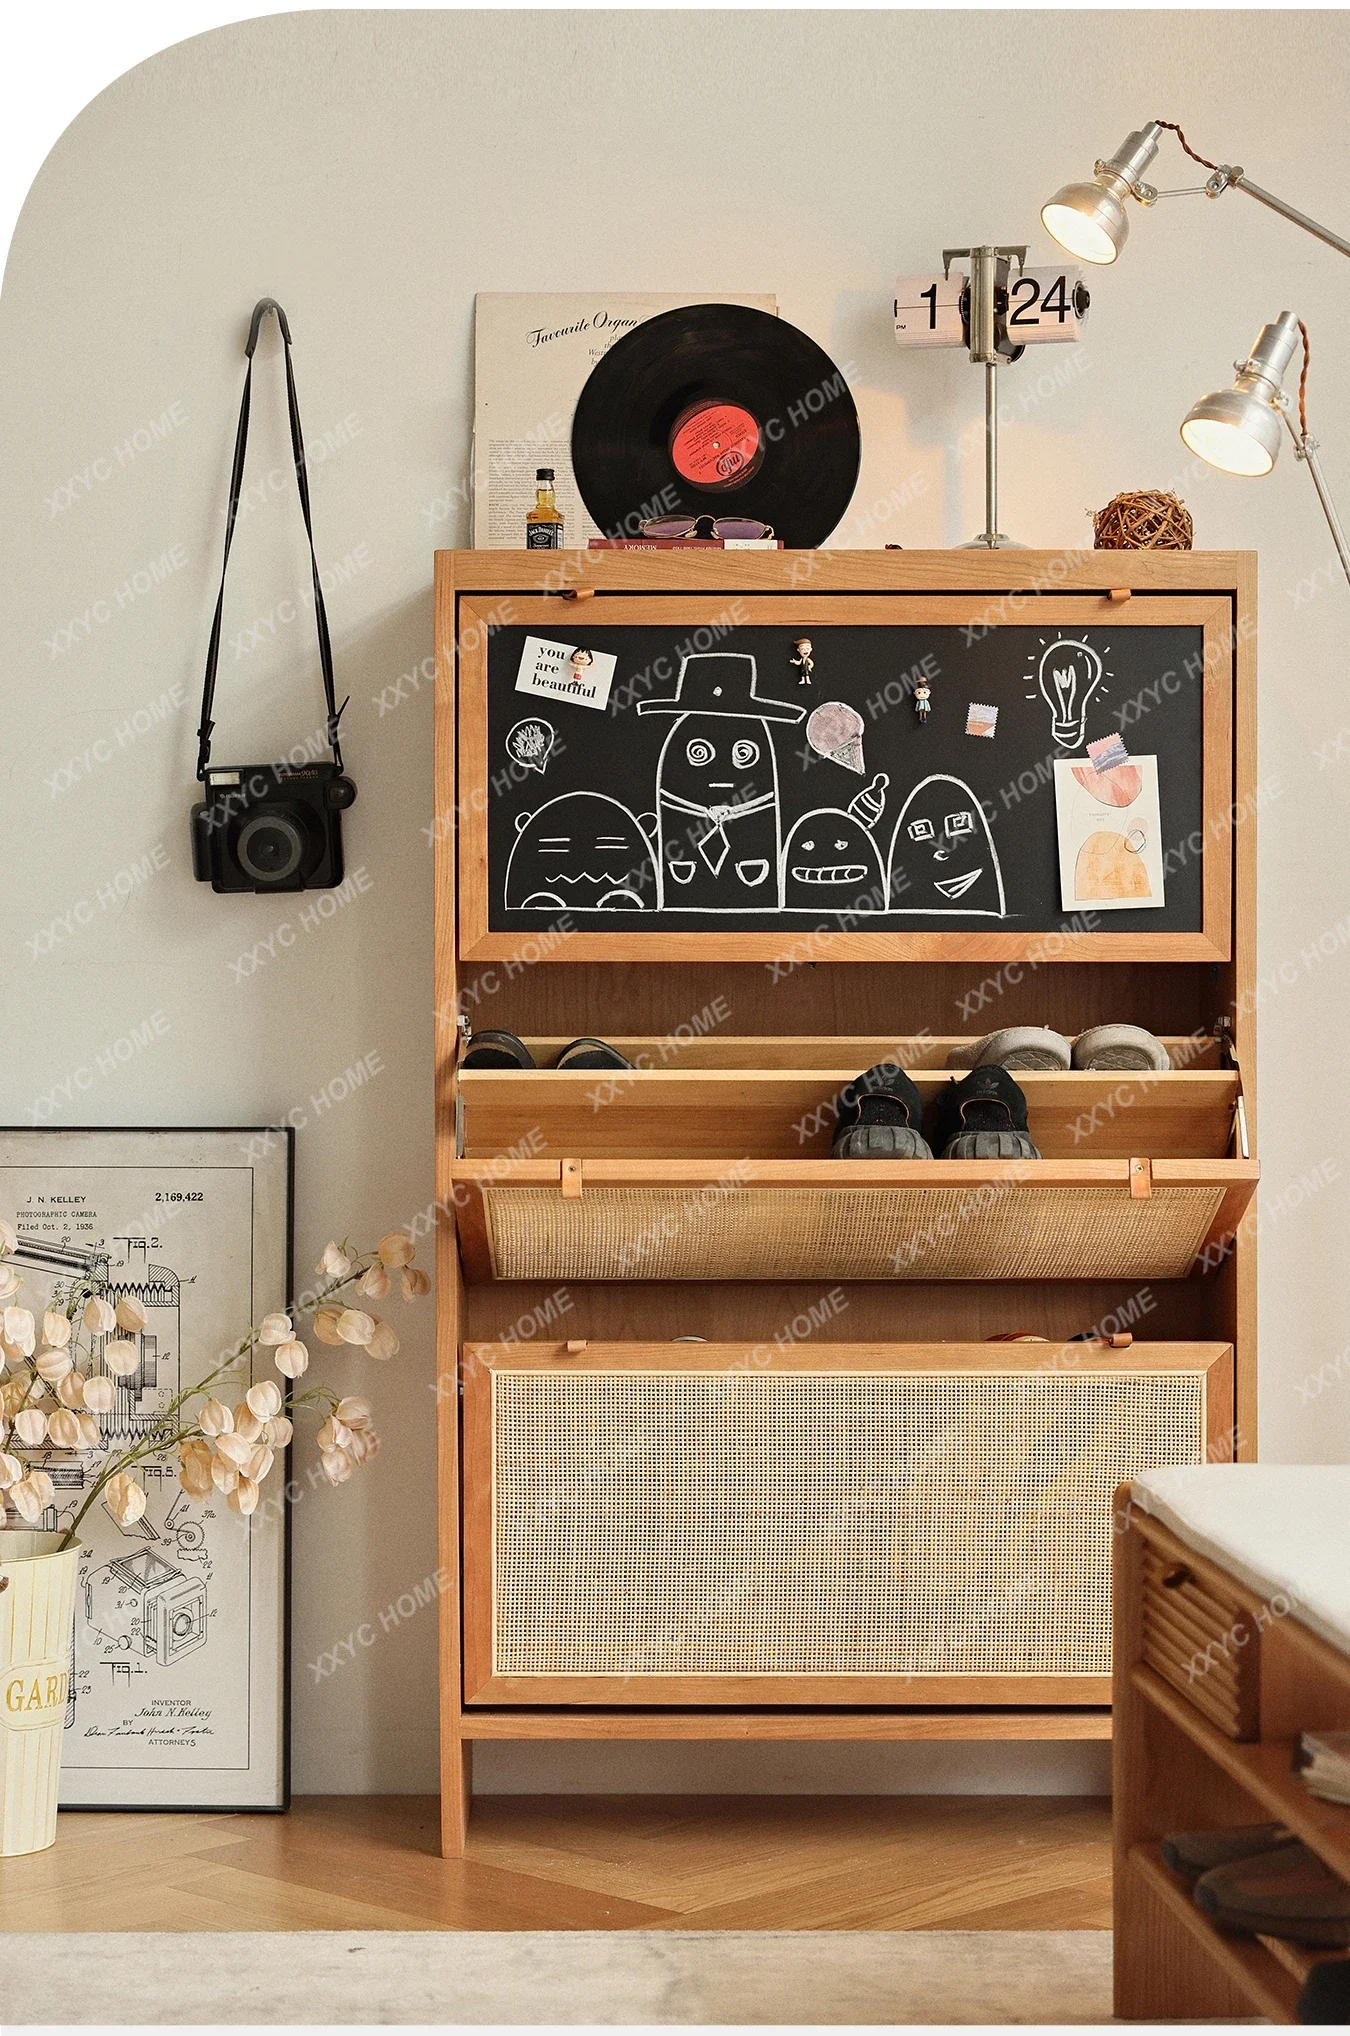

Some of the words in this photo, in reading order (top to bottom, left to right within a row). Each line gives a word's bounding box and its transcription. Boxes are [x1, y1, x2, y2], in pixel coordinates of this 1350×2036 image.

[920, 283, 937, 329] 1
[1009, 275, 1071, 325] 24
[592, 310, 638, 333] Organ
[538, 646, 565, 660] you
[535, 662, 559, 674] are
[532, 672, 597, 698] beautiful
[155, 1192, 204, 1203] 2,169,422
[135, 1708, 162, 1718] John
[148, 1739, 196, 1747] ATTORNEYS
